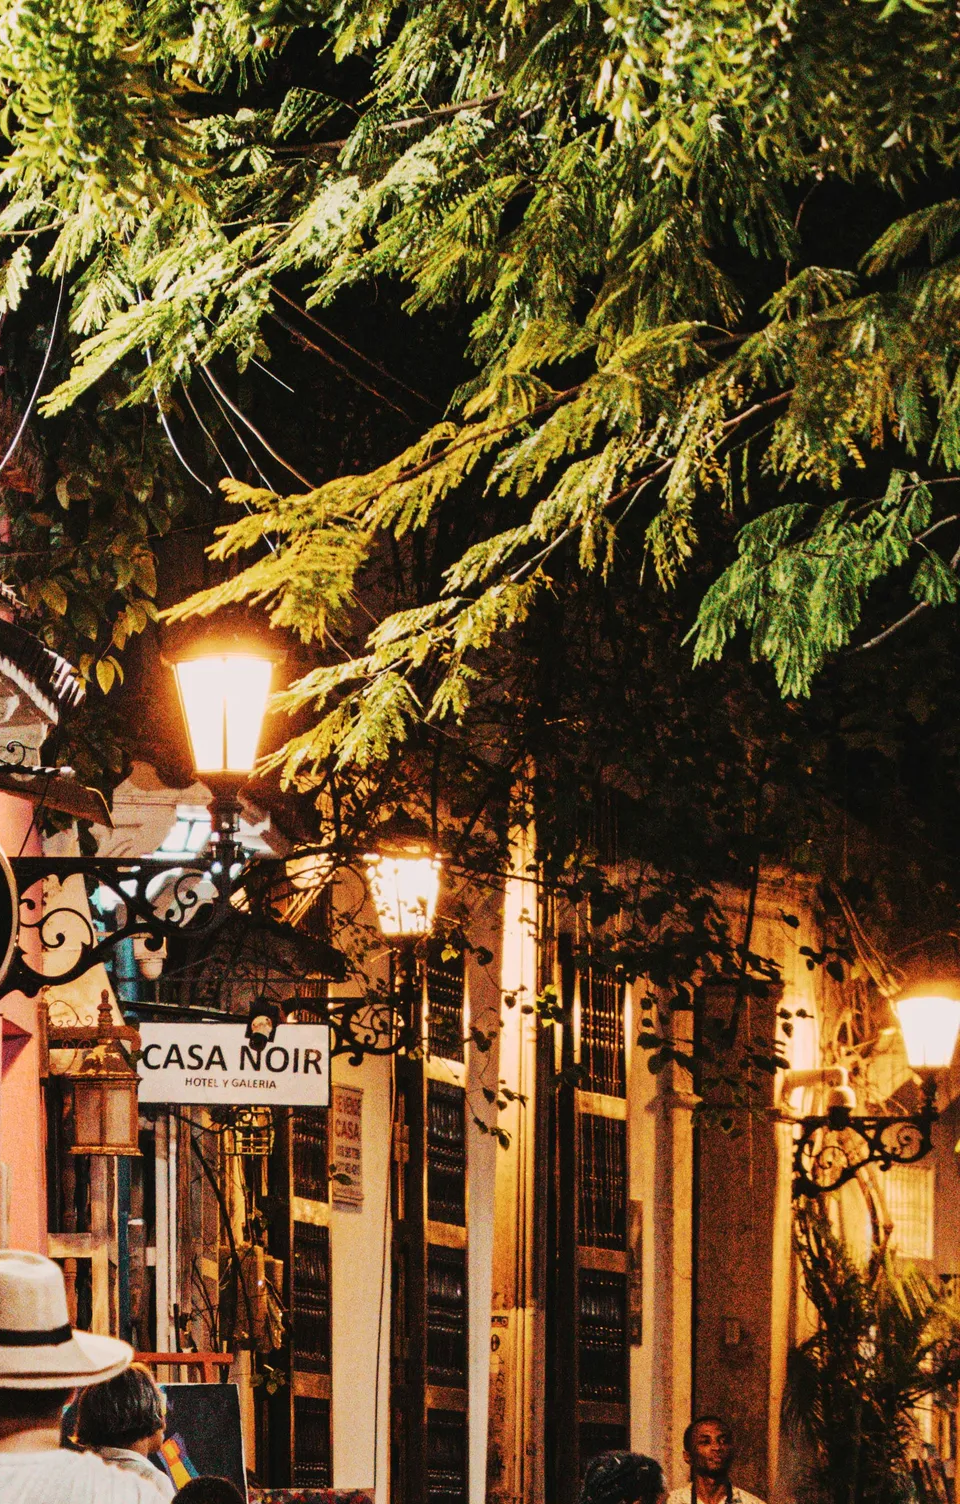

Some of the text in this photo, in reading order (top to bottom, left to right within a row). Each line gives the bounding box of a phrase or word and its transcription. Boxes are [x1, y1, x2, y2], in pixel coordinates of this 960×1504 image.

[142, 1043, 323, 1075] CASA NOIR
[185, 1077, 277, 1090] HOTEL Y GALERIA
